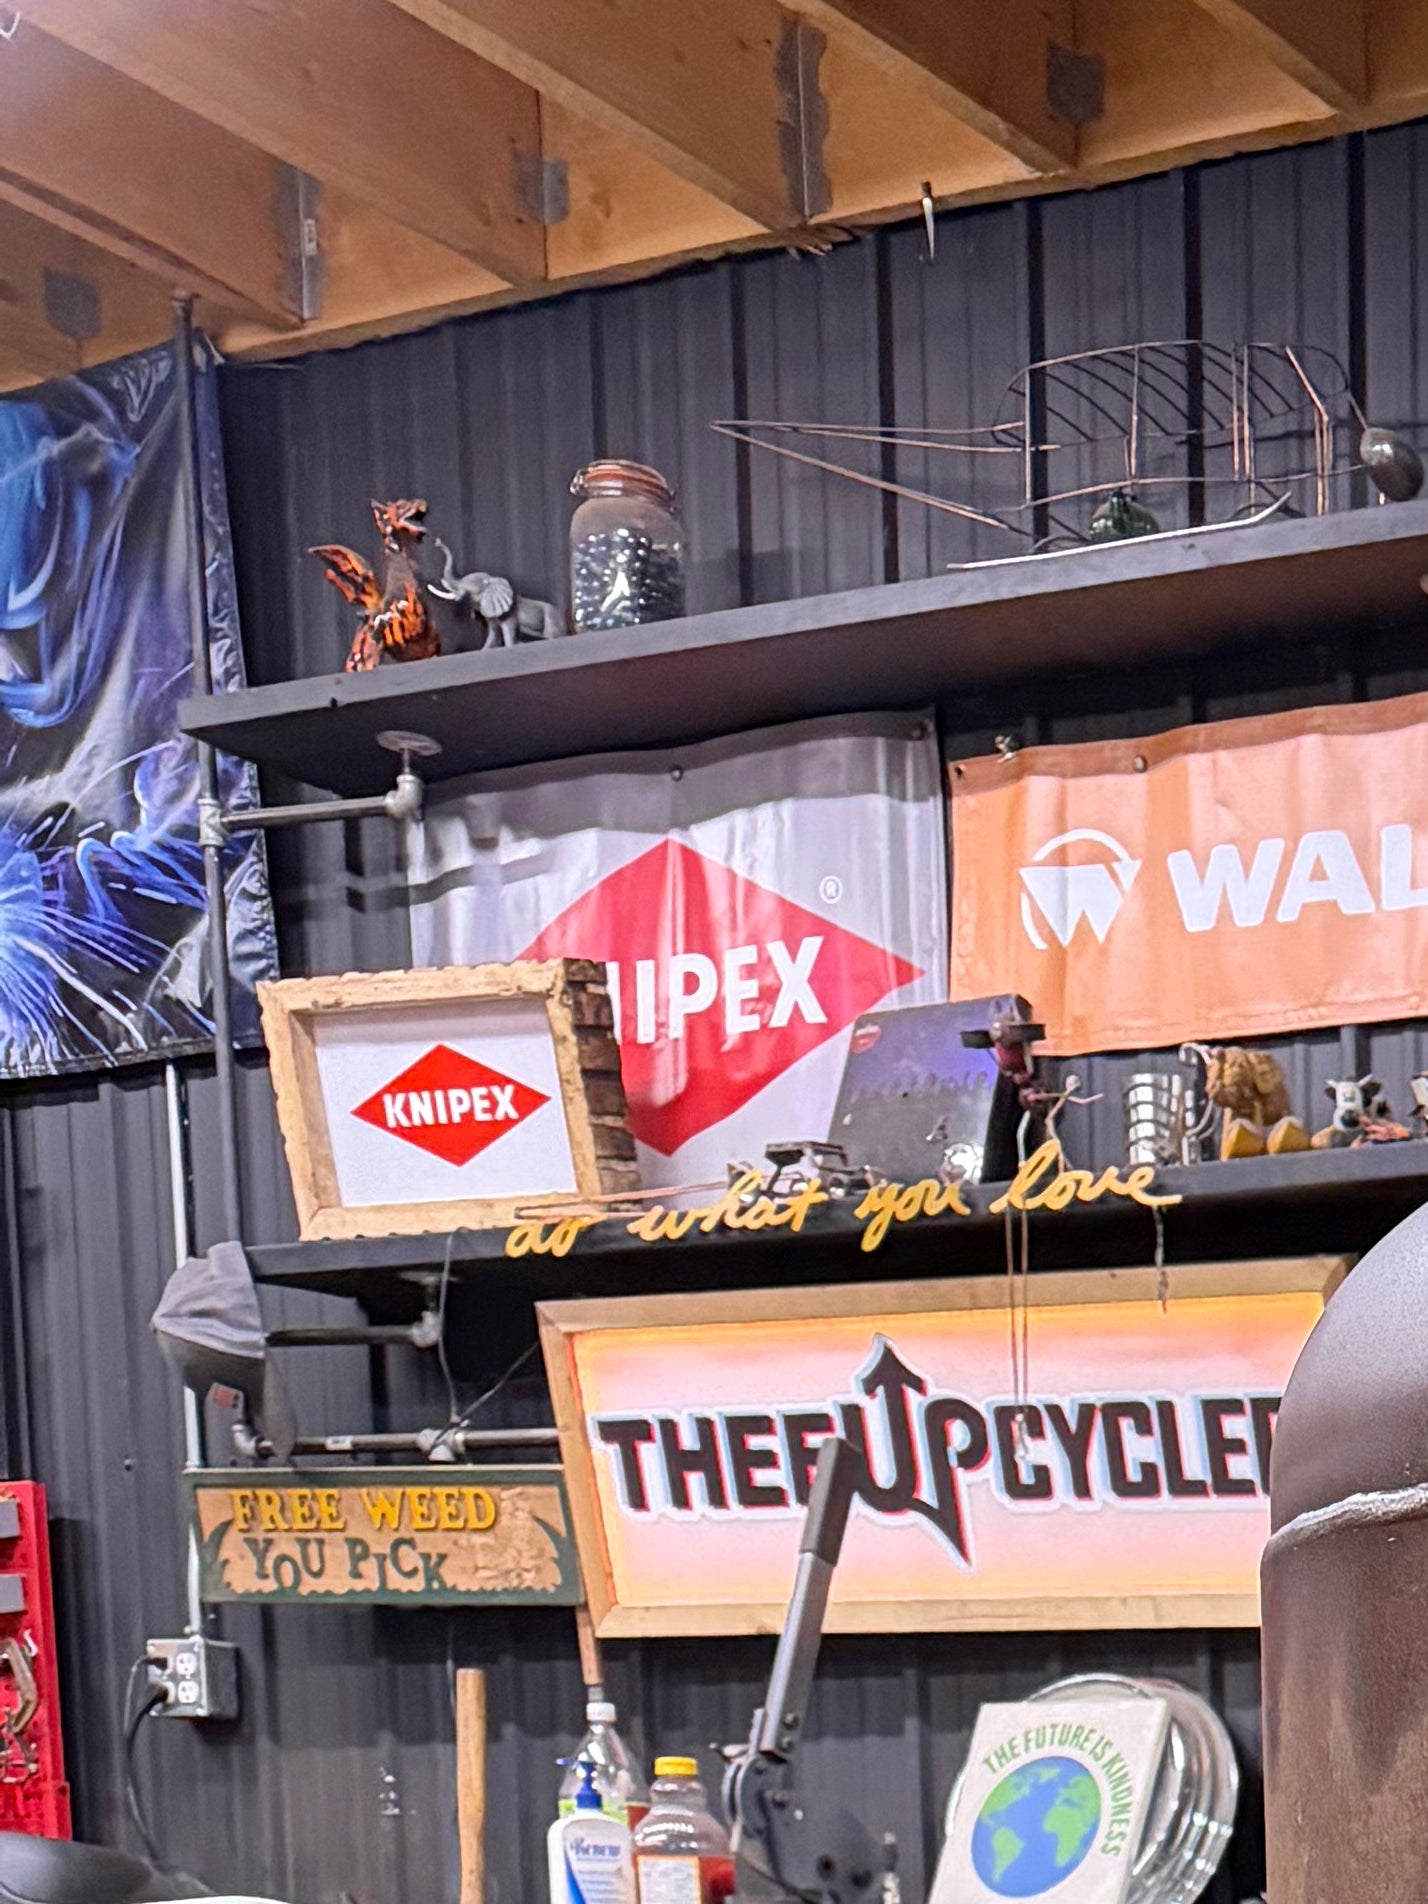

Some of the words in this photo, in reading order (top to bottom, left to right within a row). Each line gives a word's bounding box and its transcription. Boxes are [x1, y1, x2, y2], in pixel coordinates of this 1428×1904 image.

[604, 935, 828, 1047] IPEX
[383, 1084, 519, 1129] KNIPEX
[626, 1169, 828, 1242] what
[854, 1178, 971, 1252] you
[989, 1138, 1183, 1214] love
[229, 1487, 347, 1533] FREE
[360, 1487, 497, 1533] WEED
[243, 1537, 326, 1592] YOU
[345, 1536, 449, 1592] PICK
[982, 1736, 1023, 1774] THE
[1023, 1723, 1097, 1752] FUTURE
[1088, 1736, 1113, 1764] IS
[1101, 1752, 1133, 1857] KINDNESS
